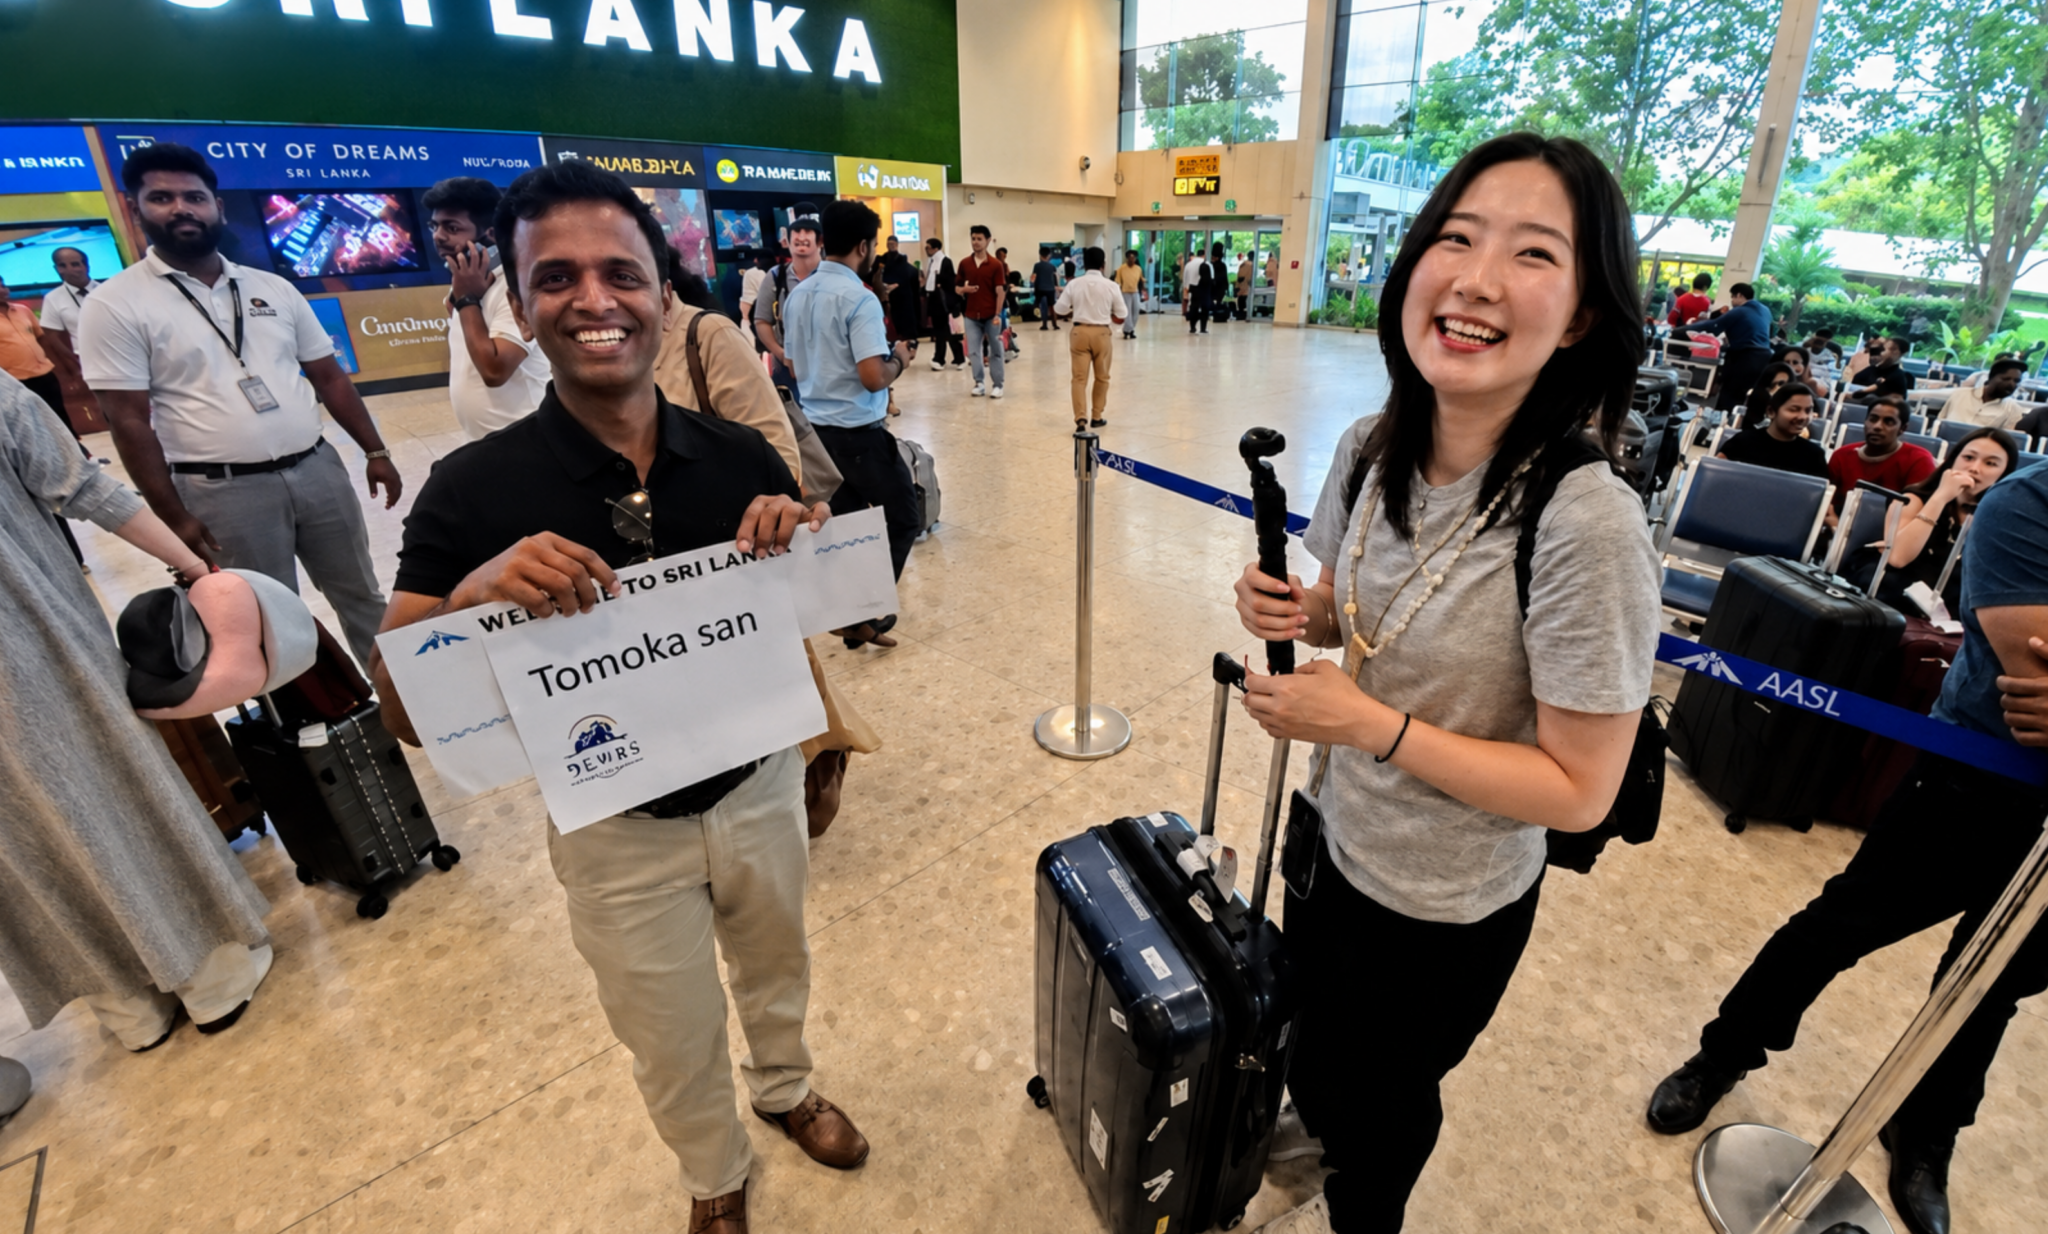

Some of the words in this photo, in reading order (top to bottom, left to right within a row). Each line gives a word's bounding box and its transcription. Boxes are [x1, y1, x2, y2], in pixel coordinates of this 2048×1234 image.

[207, 141, 267, 159] CITY
[284, 142, 316, 159] OF
[332, 143, 430, 161] DREAMS
[286, 168, 311, 178] SRI
[320, 168, 371, 178] LANKA
[478, 584, 617, 632] WELE
[621, 574, 657, 595] TO
[663, 561, 703, 584] SRI
[708, 548, 792, 572] LAN
[528, 632, 688, 697] Tomoka
[697, 612, 758, 647] san
[1756, 672, 1841, 717] AASL
